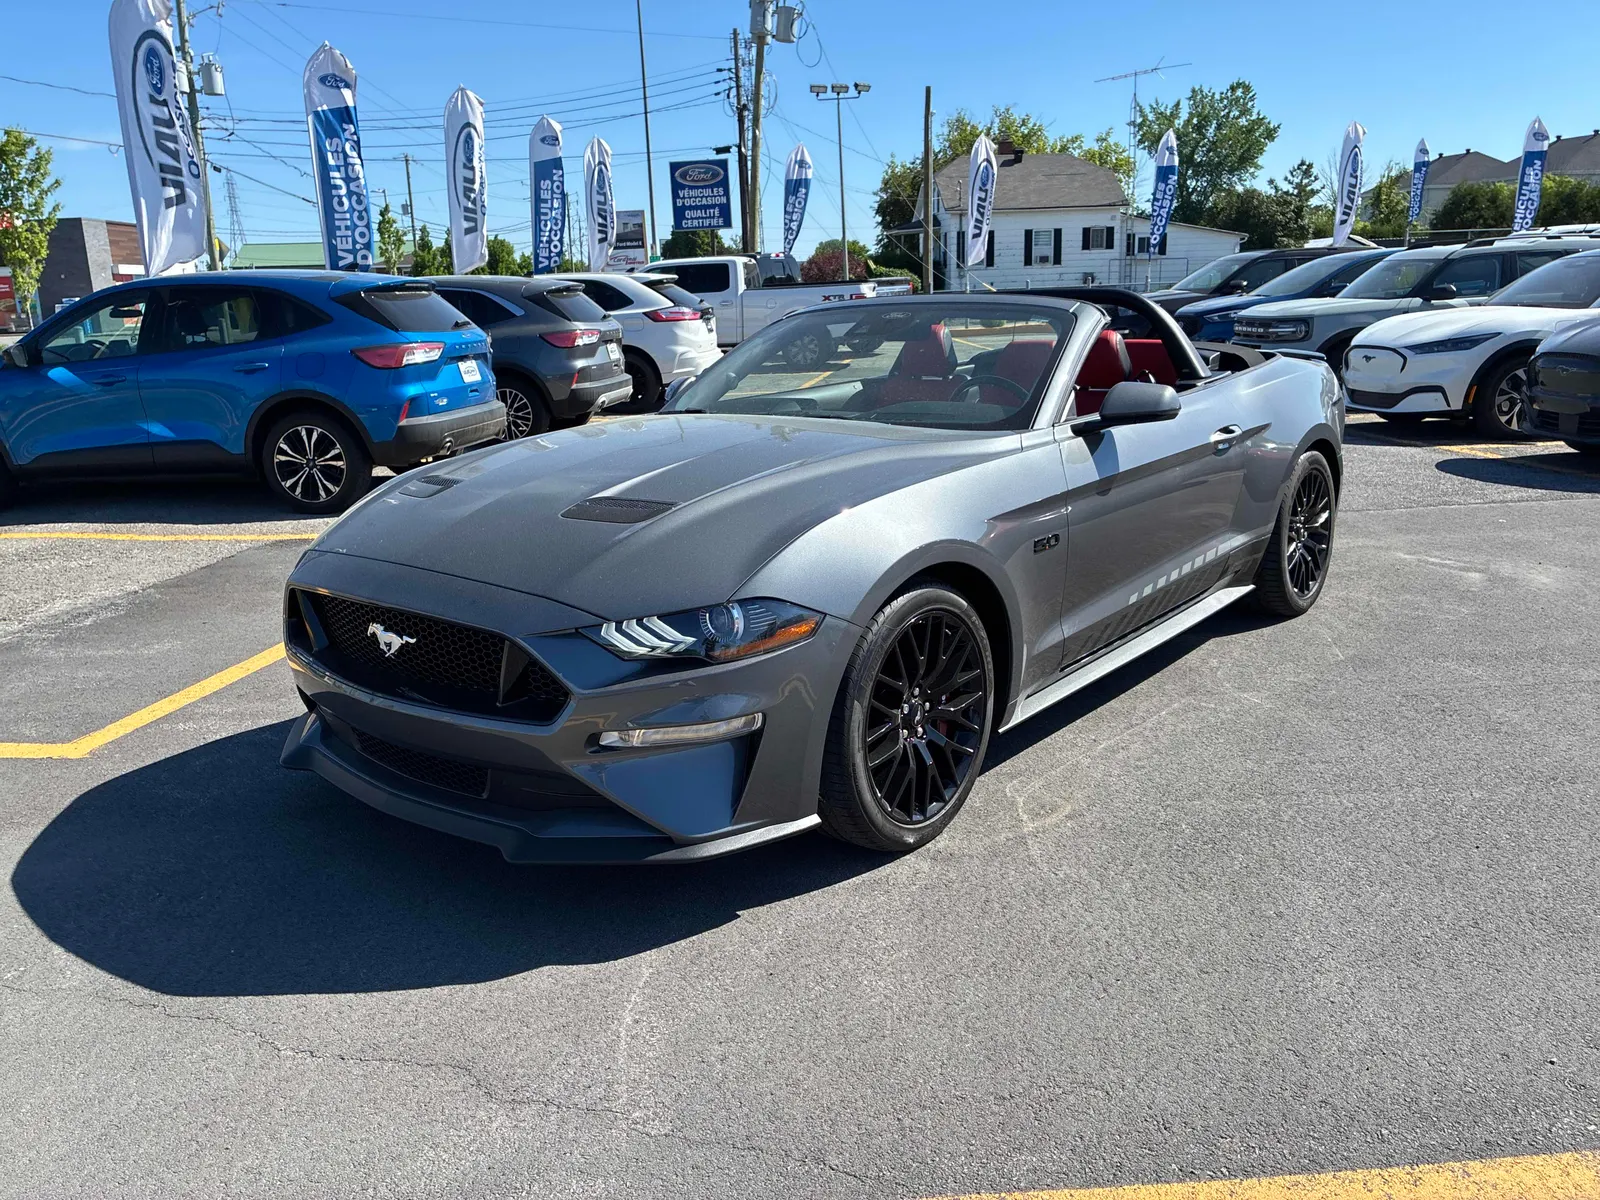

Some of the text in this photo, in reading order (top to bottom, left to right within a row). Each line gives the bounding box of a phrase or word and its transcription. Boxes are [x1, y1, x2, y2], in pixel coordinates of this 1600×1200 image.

[149, 57, 161, 88] Ford
[325, 75, 345, 87] Ford
[149, 93, 186, 210] VIAU
[686, 168, 712, 181] Ford
[326, 137, 354, 268] VÉHICULES
[342, 123, 373, 265] D'OCCASION
[463, 162, 478, 236] VIAU
[550, 168, 563, 267] D'OCCASION
[596, 189, 608, 245] VIAU
[676, 196, 727, 206] D'OCCASION
[678, 187, 724, 198] VÉHICULES
[685, 206, 720, 218] QUALITÉ
[971, 186, 988, 240] VIAU
[1339, 172, 1358, 226] VIAU
[538, 179, 551, 268] VÉHICULES
[682, 217, 724, 228] CERTIFIÉE
